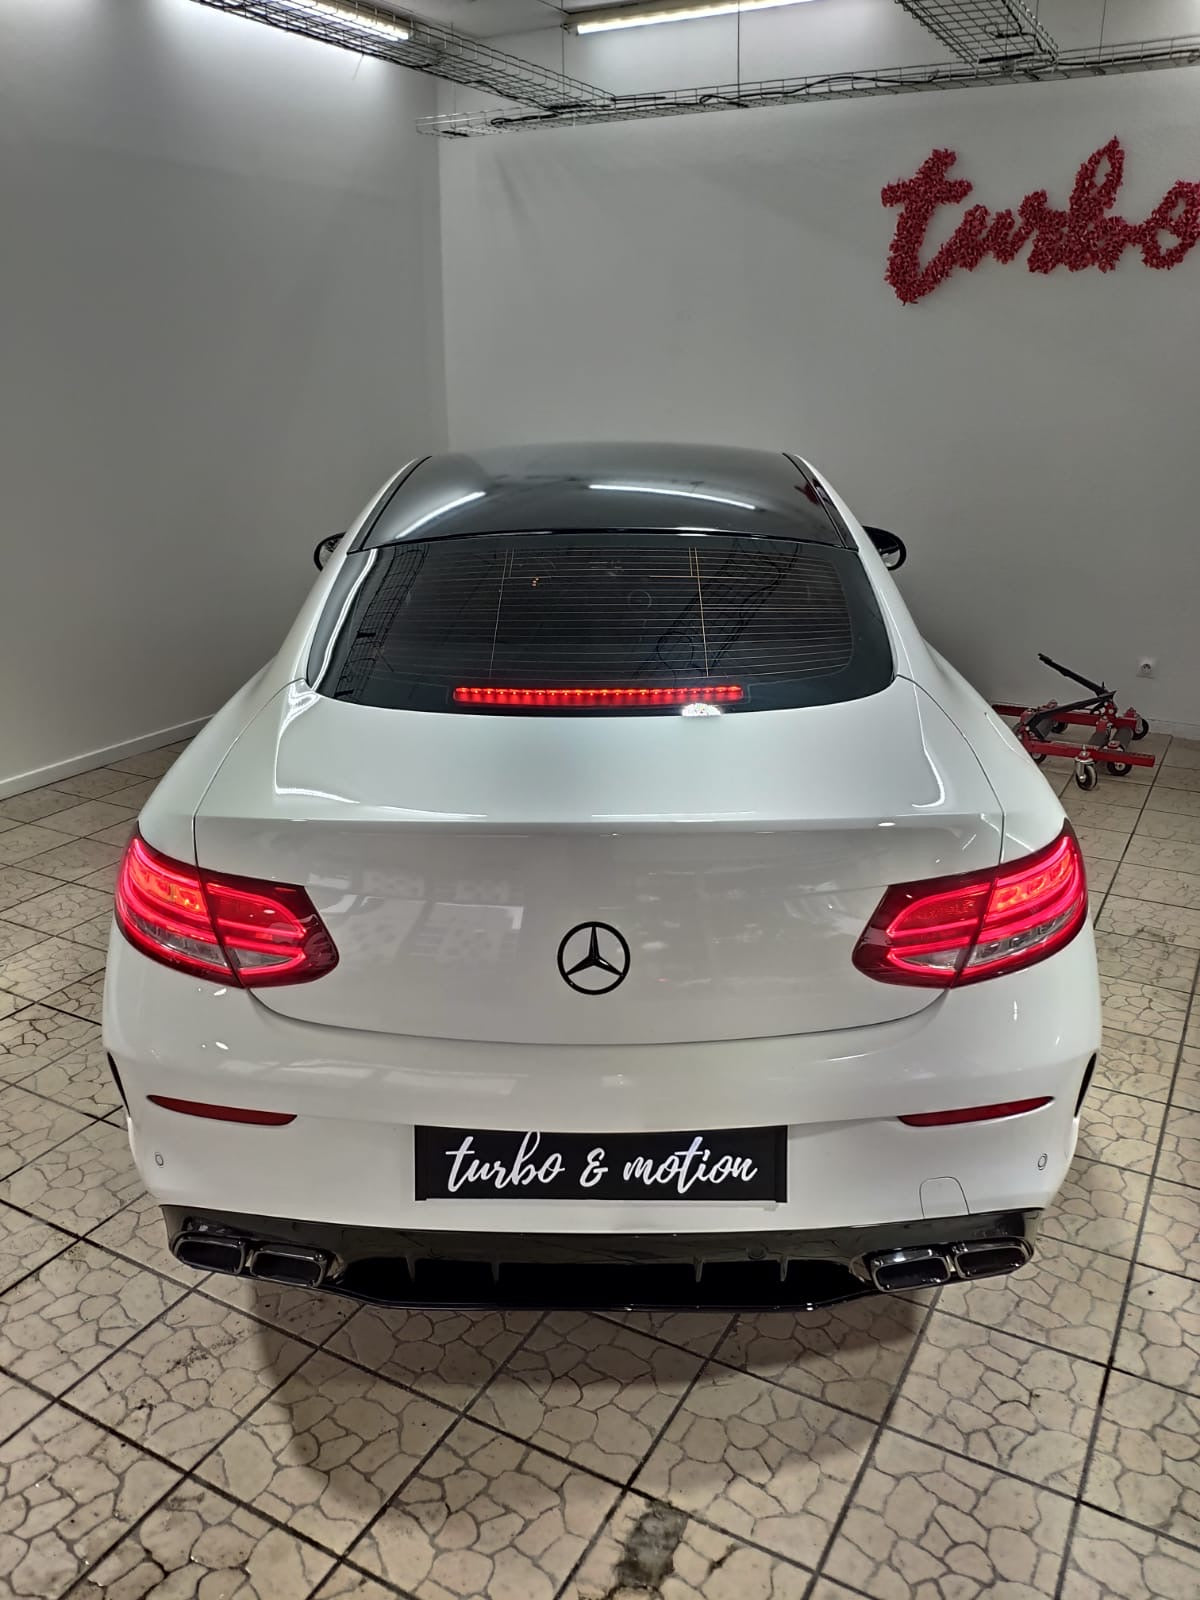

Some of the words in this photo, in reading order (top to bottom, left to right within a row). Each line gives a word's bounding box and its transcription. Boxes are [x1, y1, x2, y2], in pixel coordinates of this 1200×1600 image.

[881, 136, 1200, 304] turbo
[446, 1130, 565, 1192] turbo
[579, 1148, 608, 1187] &
[623, 1136, 757, 1194] motion
